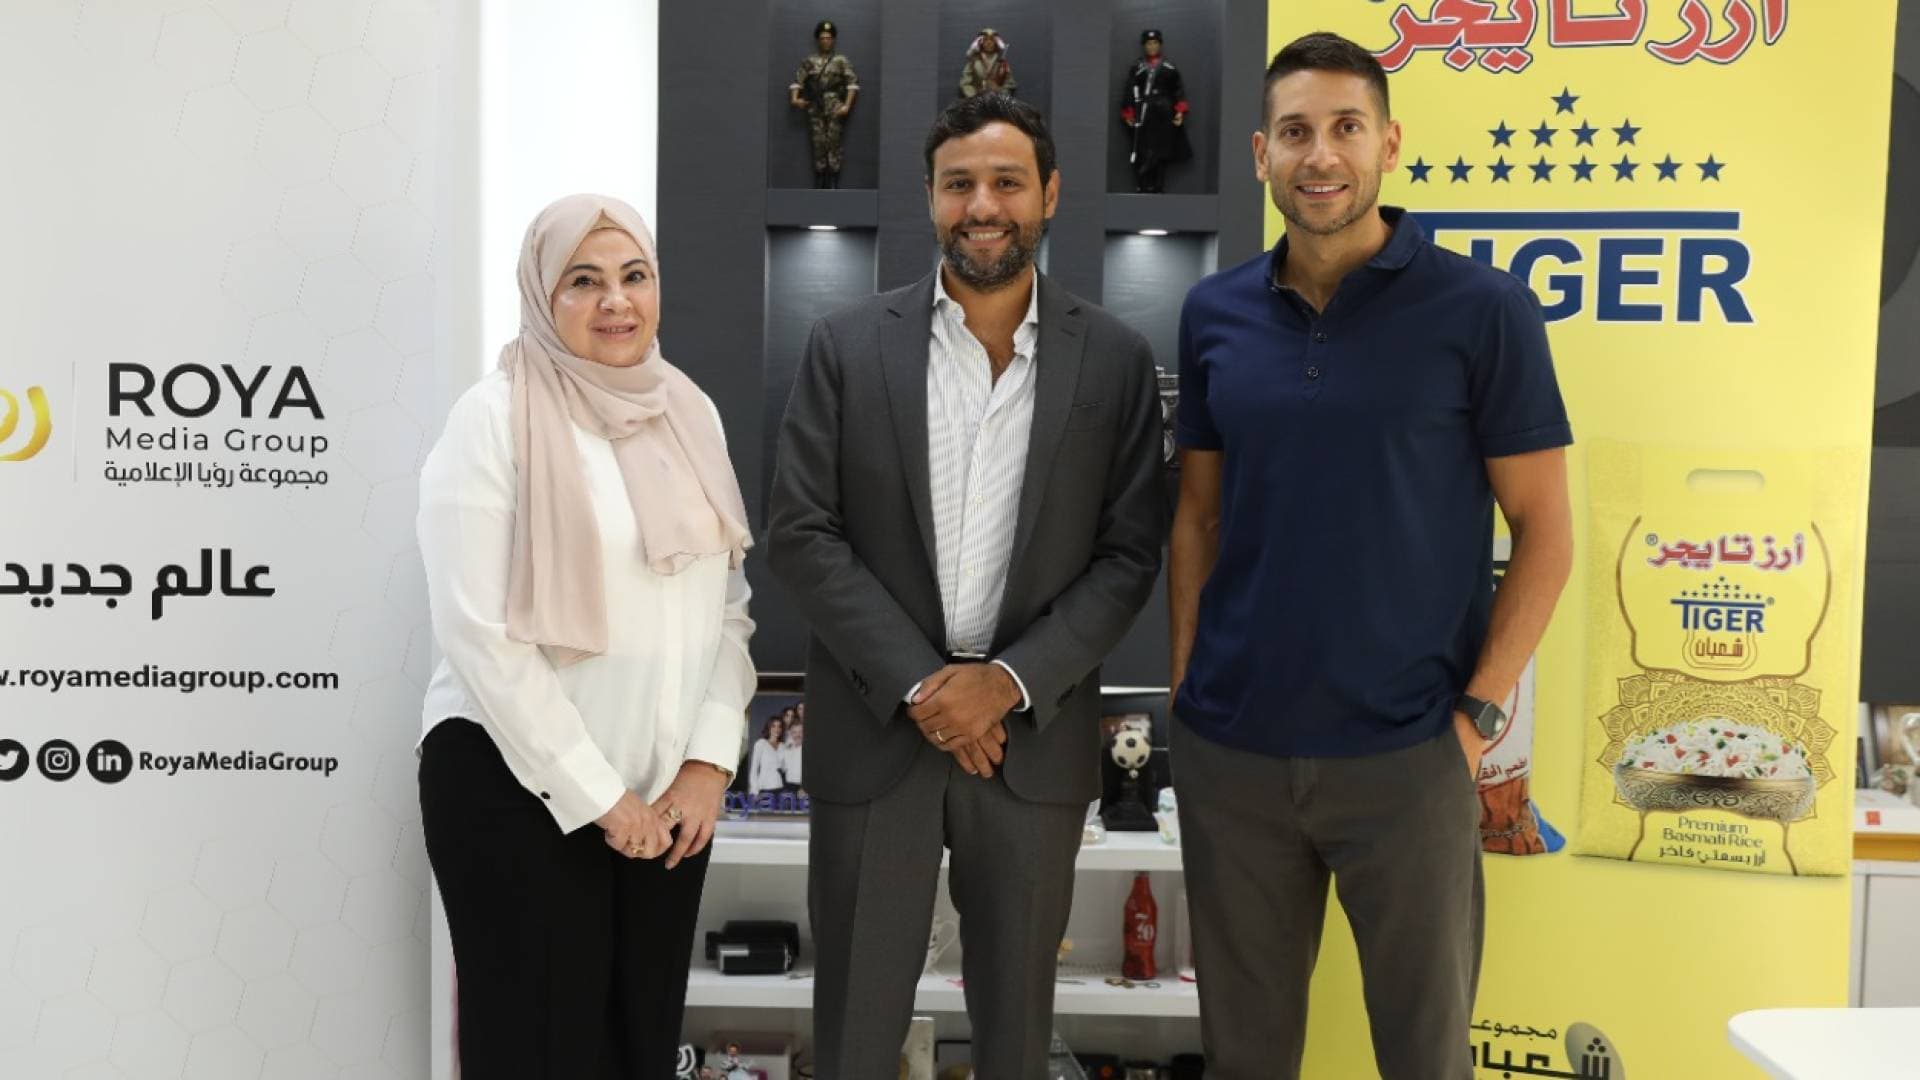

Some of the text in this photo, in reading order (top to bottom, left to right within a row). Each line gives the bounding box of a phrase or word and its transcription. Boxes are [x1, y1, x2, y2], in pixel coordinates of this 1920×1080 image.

[108, 362, 325, 420] ROYA
[106, 427, 329, 459] Media Group
[103, 460, 329, 490] مجموعة رؤيا الإعلامية
[1647, 533, 1804, 571] أرز تايجر
[0, 547, 276, 621] عالم جديد
[1670, 598, 1766, 634] TIGER
[139, 750, 339, 778] RoyaMediaGroup
[1663, 827, 1763, 848] Basmati Rice
[1678, 816, 1749, 834] Premium
[1470, 1019, 1557, 1041] مجموع
[1470, 1036, 1611, 1080] شعبا
